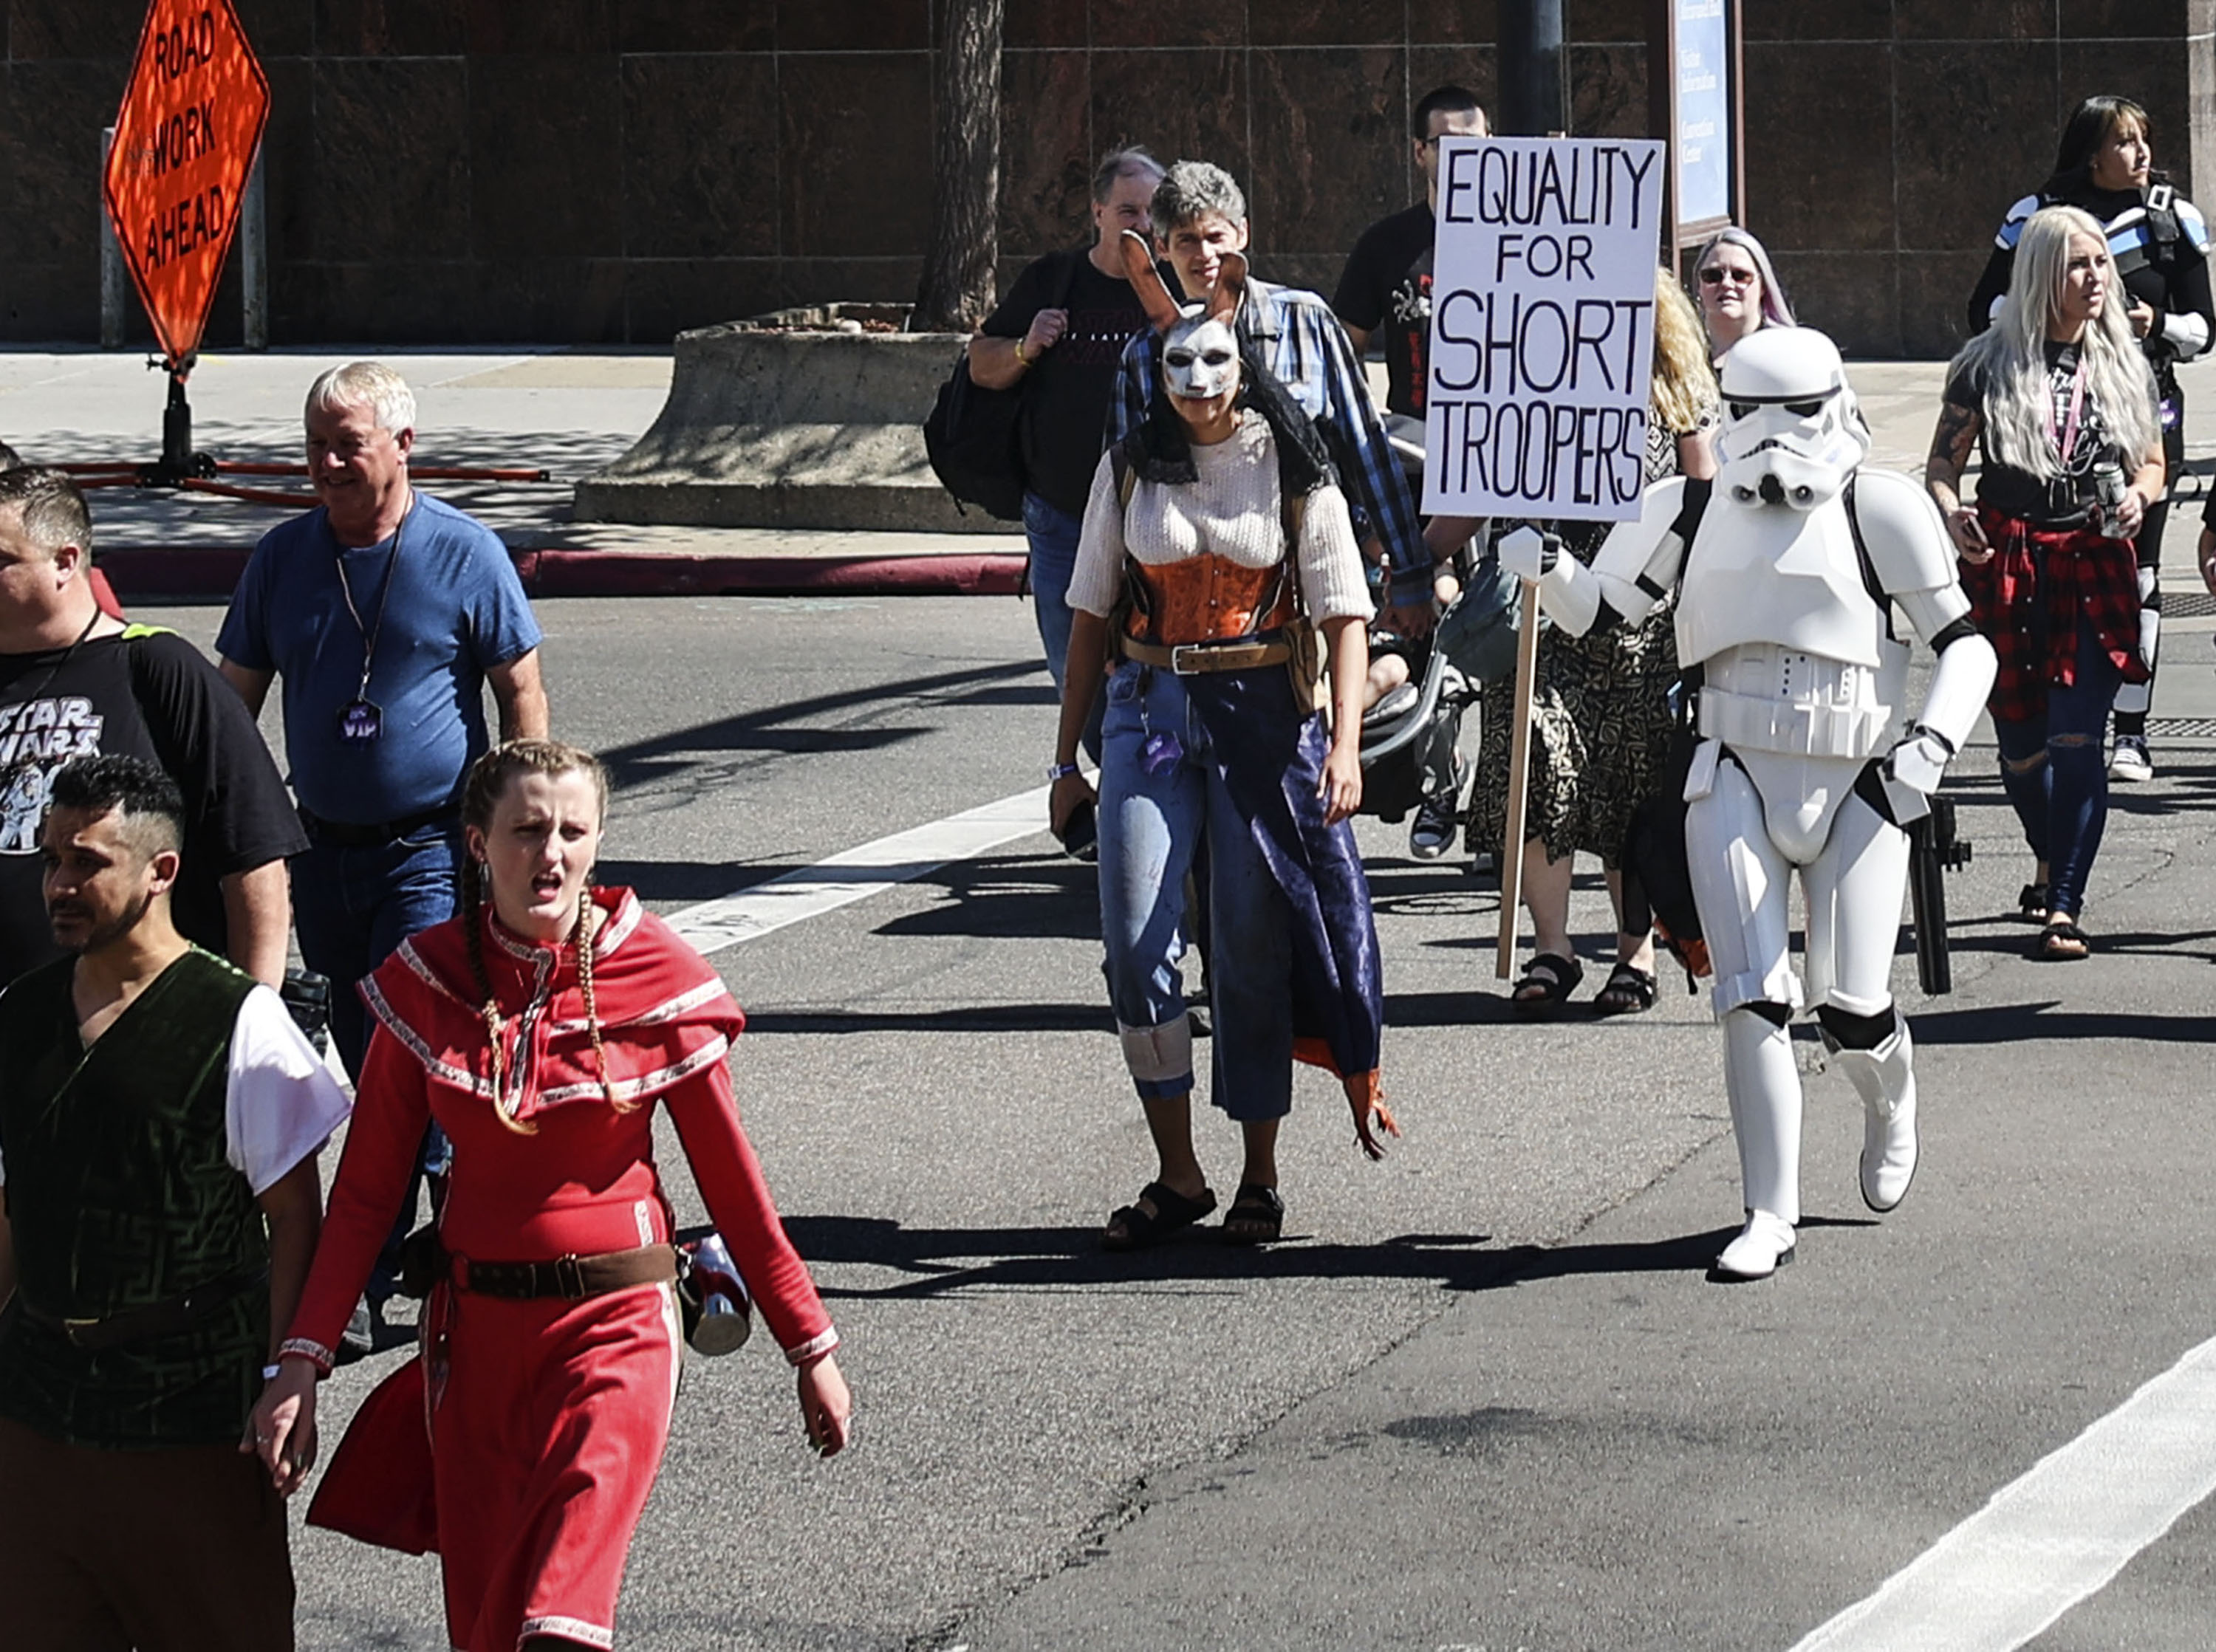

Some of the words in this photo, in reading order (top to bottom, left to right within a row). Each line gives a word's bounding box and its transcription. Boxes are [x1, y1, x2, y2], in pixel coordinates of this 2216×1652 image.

[156, 10, 215, 83] ROAD
[152, 97, 216, 179] WORK
[1446, 146, 1656, 229] EQUALITY
[145, 185, 224, 275] AHEAD
[1496, 234, 1595, 283] FOR
[1434, 289, 1652, 396] SHORT
[1431, 400, 1645, 506] TROOPERS
[343, 720, 376, 737] VIP
